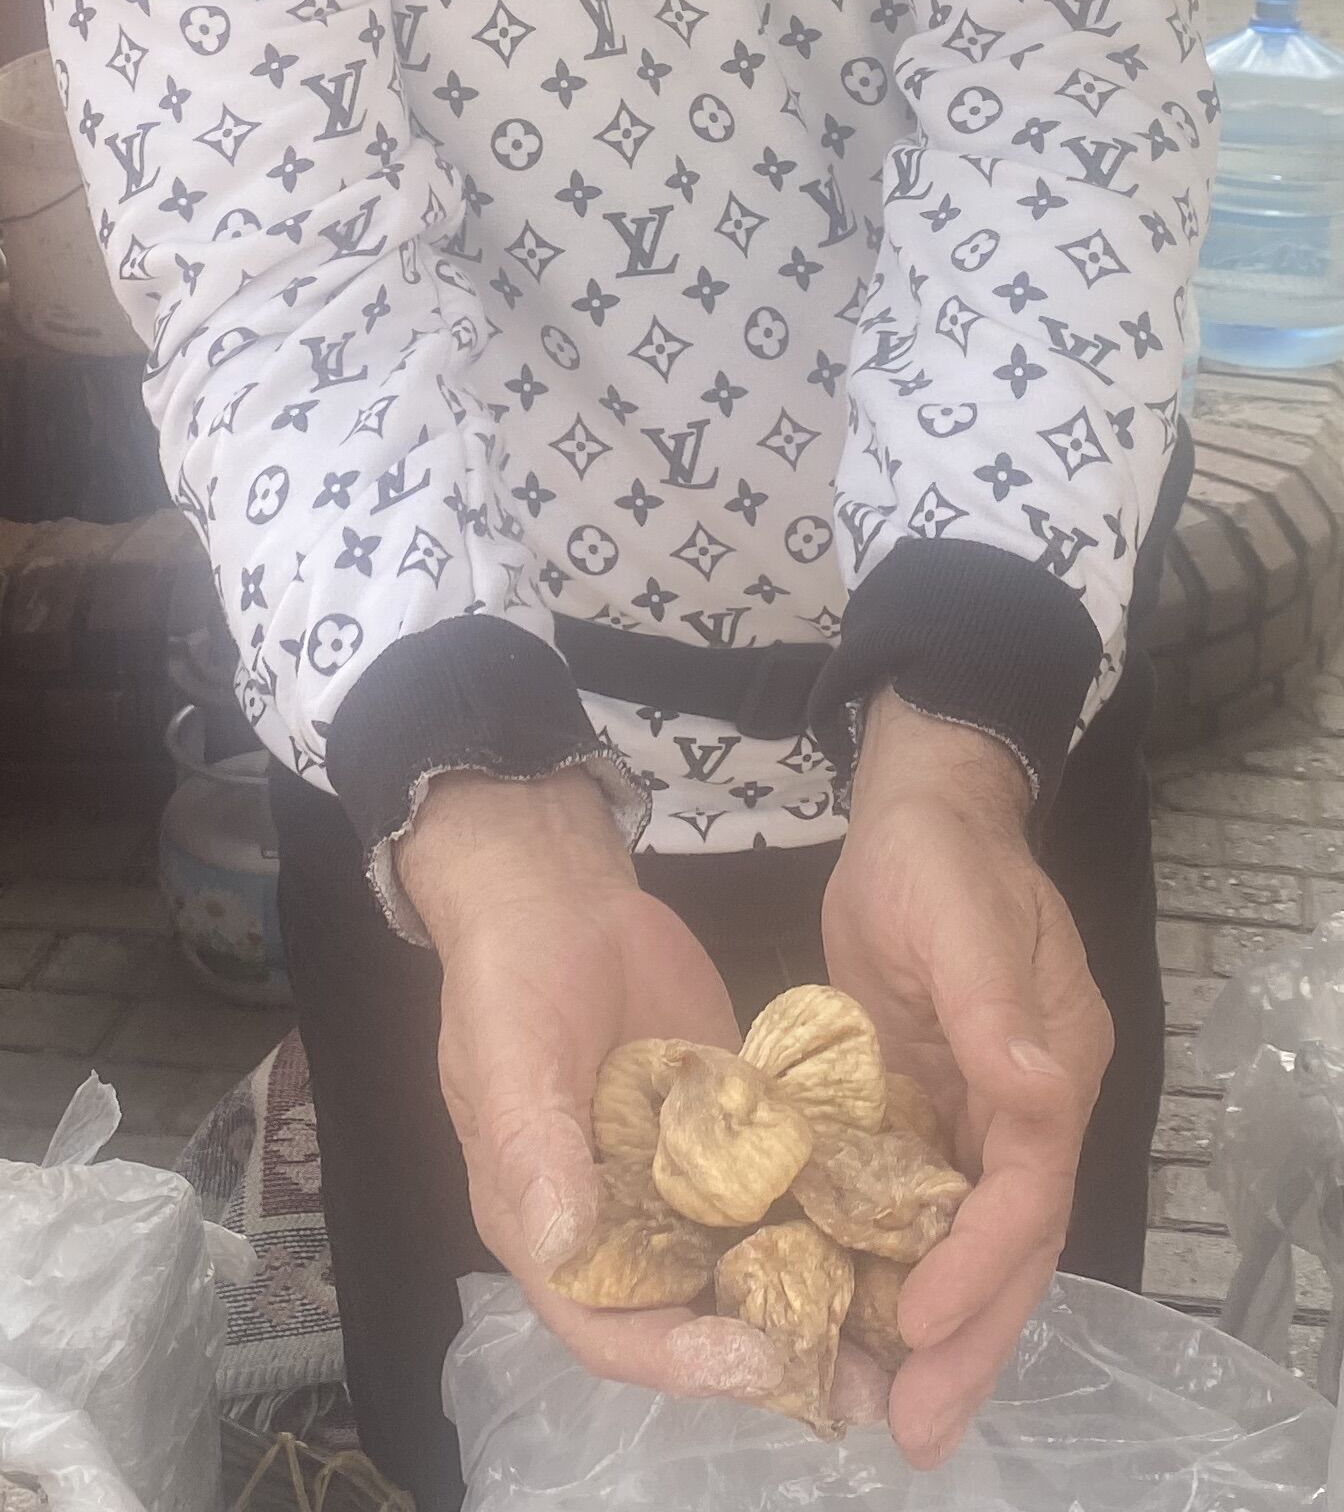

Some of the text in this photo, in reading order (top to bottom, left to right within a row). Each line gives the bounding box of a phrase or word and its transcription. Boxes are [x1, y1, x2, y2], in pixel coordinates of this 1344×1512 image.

[301, 59, 367, 142] LV
[602, 205, 680, 279] LV
[640, 418, 719, 489] LV
